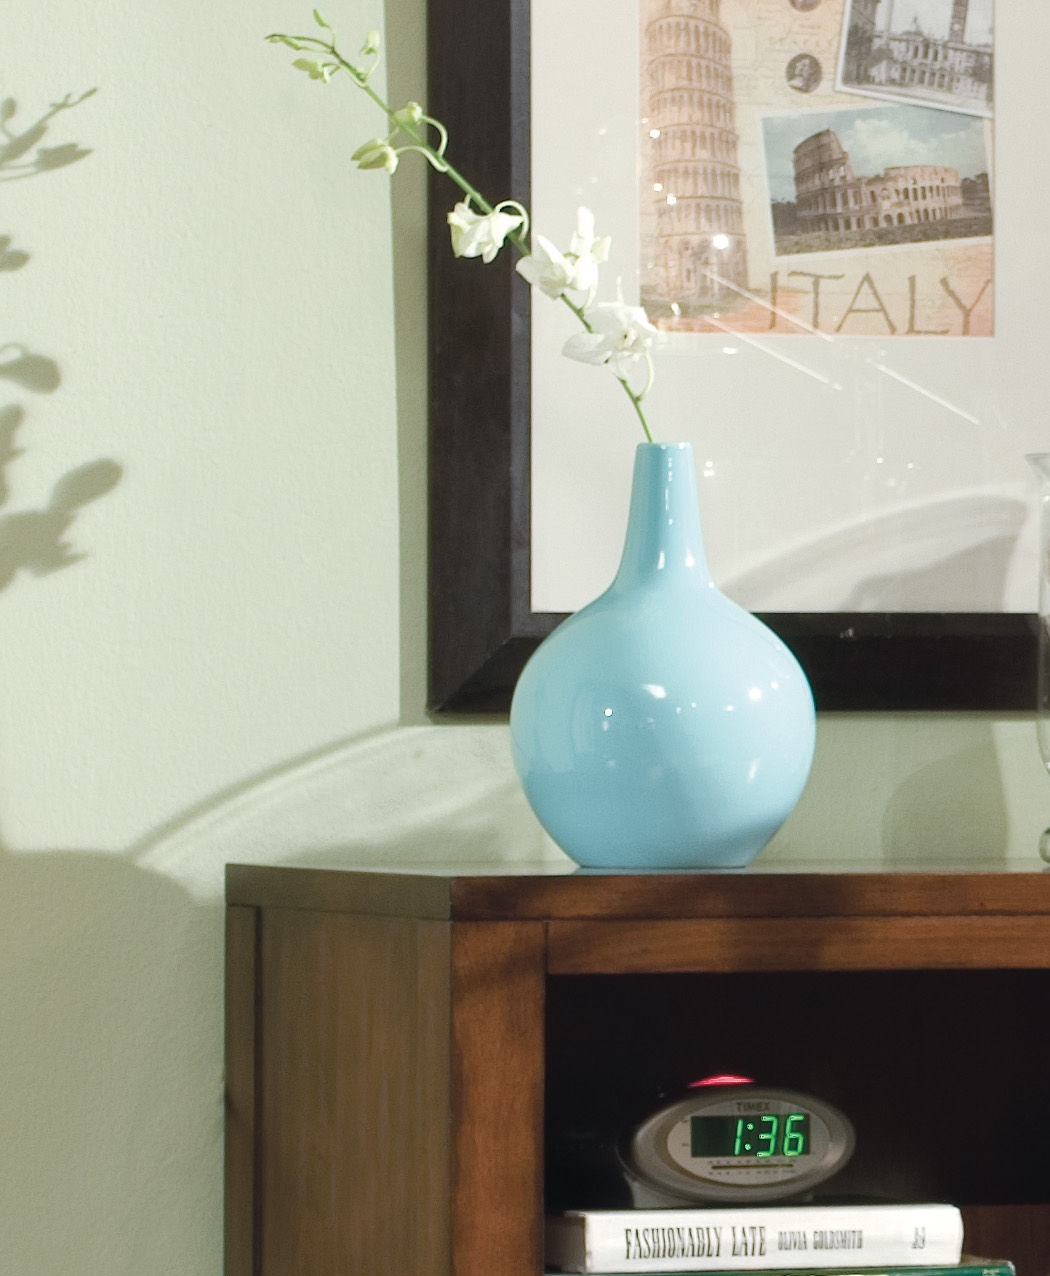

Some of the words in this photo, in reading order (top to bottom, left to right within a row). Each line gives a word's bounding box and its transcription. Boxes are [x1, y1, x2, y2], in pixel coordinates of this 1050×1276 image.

[768, 271, 992, 335] ITALY
[736, 1102, 771, 1112] TIMEX
[734, 1113, 805, 1157] 1:36
[625, 1226, 722, 1260] FASHIONABLY
[731, 1226, 767, 1256] LATE
[778, 1231, 808, 1251] OLIVIA
[813, 1230, 863, 1250] GOLDSMITH
